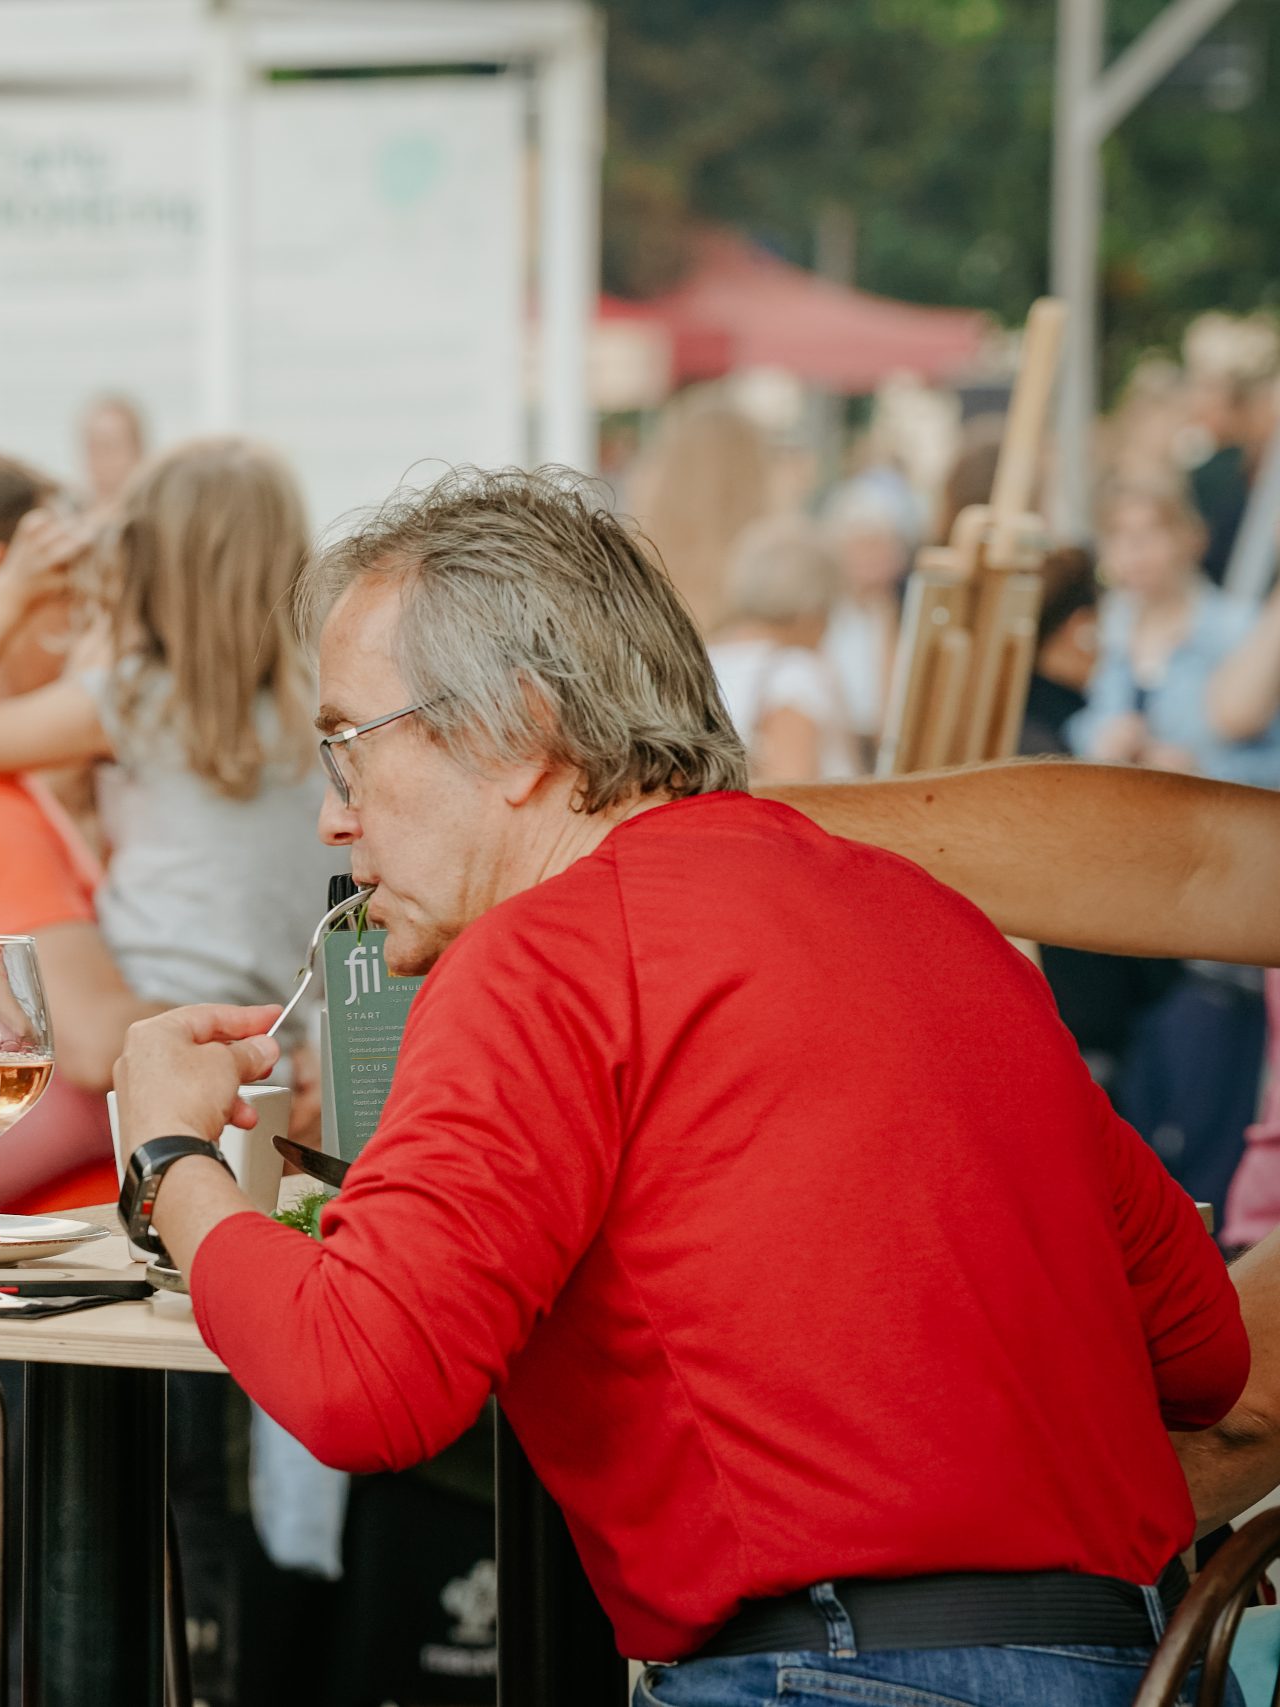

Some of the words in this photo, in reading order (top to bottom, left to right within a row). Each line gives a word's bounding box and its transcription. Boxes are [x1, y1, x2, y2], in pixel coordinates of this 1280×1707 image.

[344, 946, 381, 1006] fii
[346, 1011, 381, 1021] START
[350, 1063, 388, 1073] FOCUS
